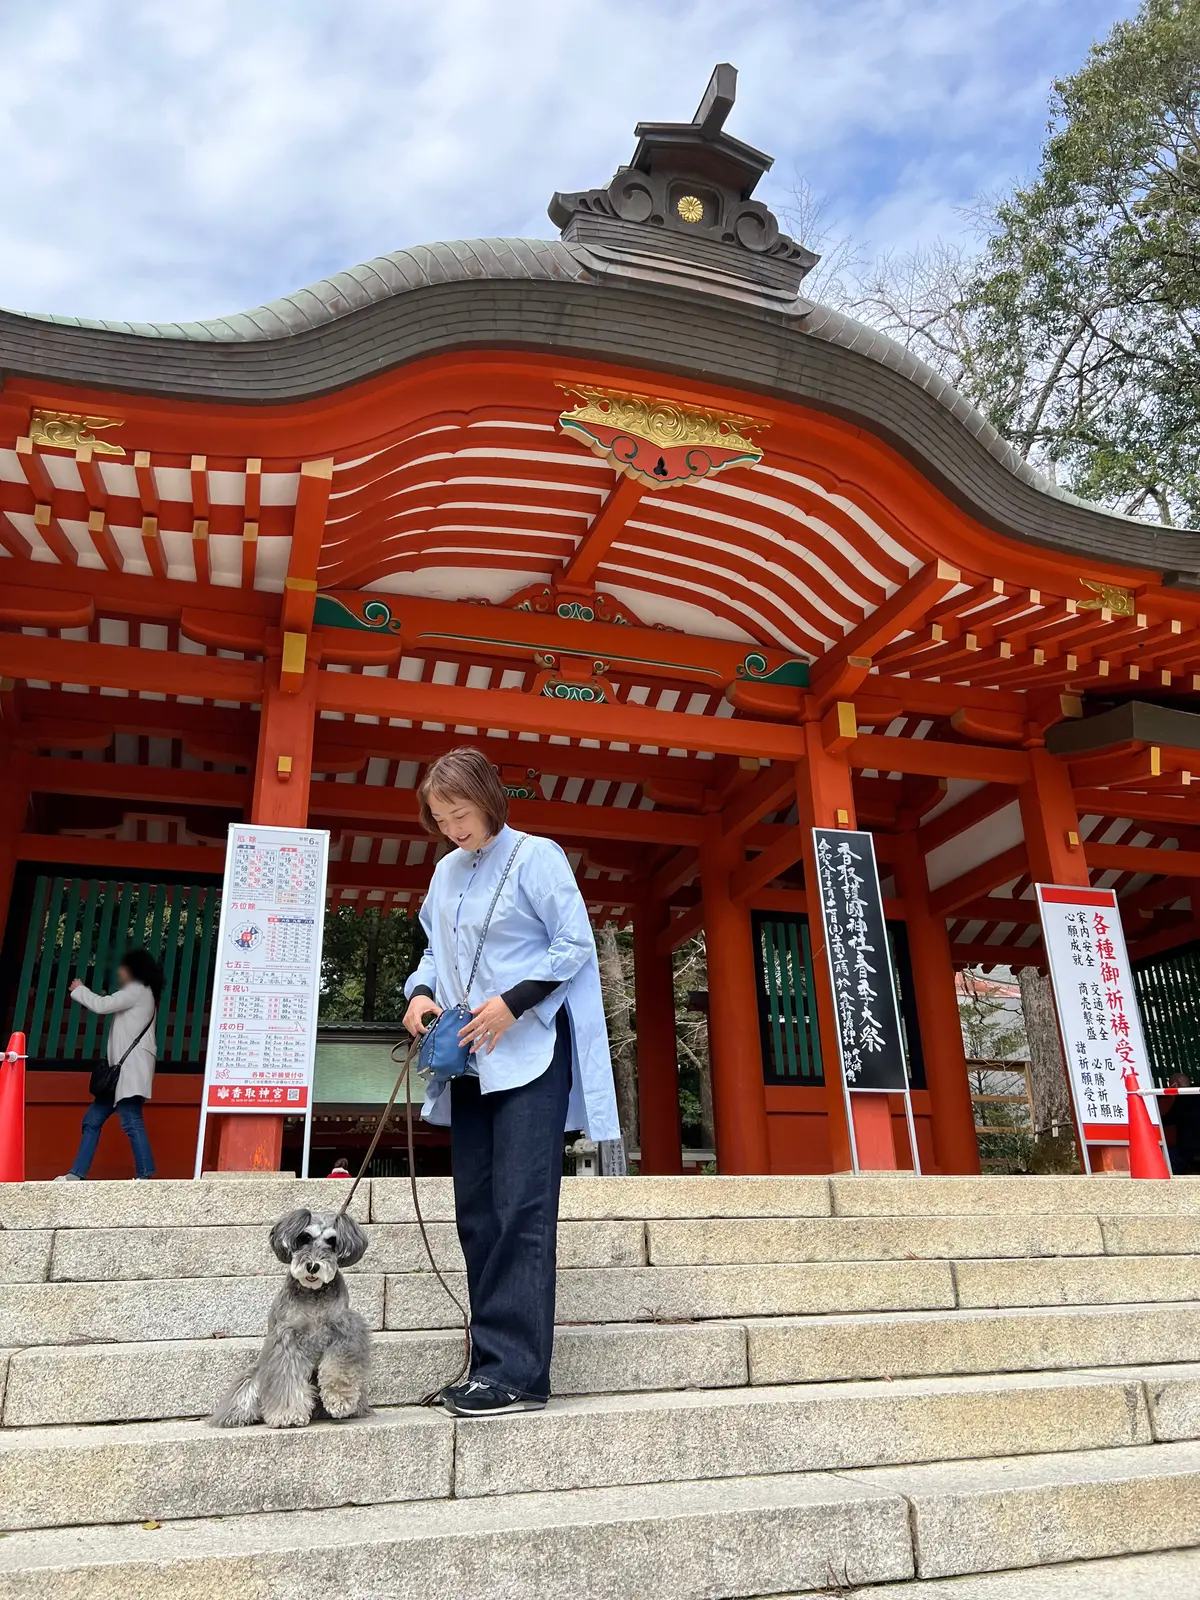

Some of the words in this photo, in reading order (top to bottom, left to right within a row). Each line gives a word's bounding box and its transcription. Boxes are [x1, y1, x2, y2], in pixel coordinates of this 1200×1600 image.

[236, 835, 256, 843] 厄除
[231, 902, 256, 910] 方位除
[1064, 913, 1084, 967] 心願成就
[1076, 911, 1095, 968] 家内安全
[225, 961, 251, 969] 七五三
[223, 984, 249, 993] 年祝い
[1091, 982, 1109, 1042] 交通安全
[219, 1022, 245, 1031] 戌の日
[1075, 1041, 1098, 1118] 諸祈願受付
[232, 1087, 284, 1098] 香取神宮
[1092, 1058, 1113, 1118] 必勝祈願
